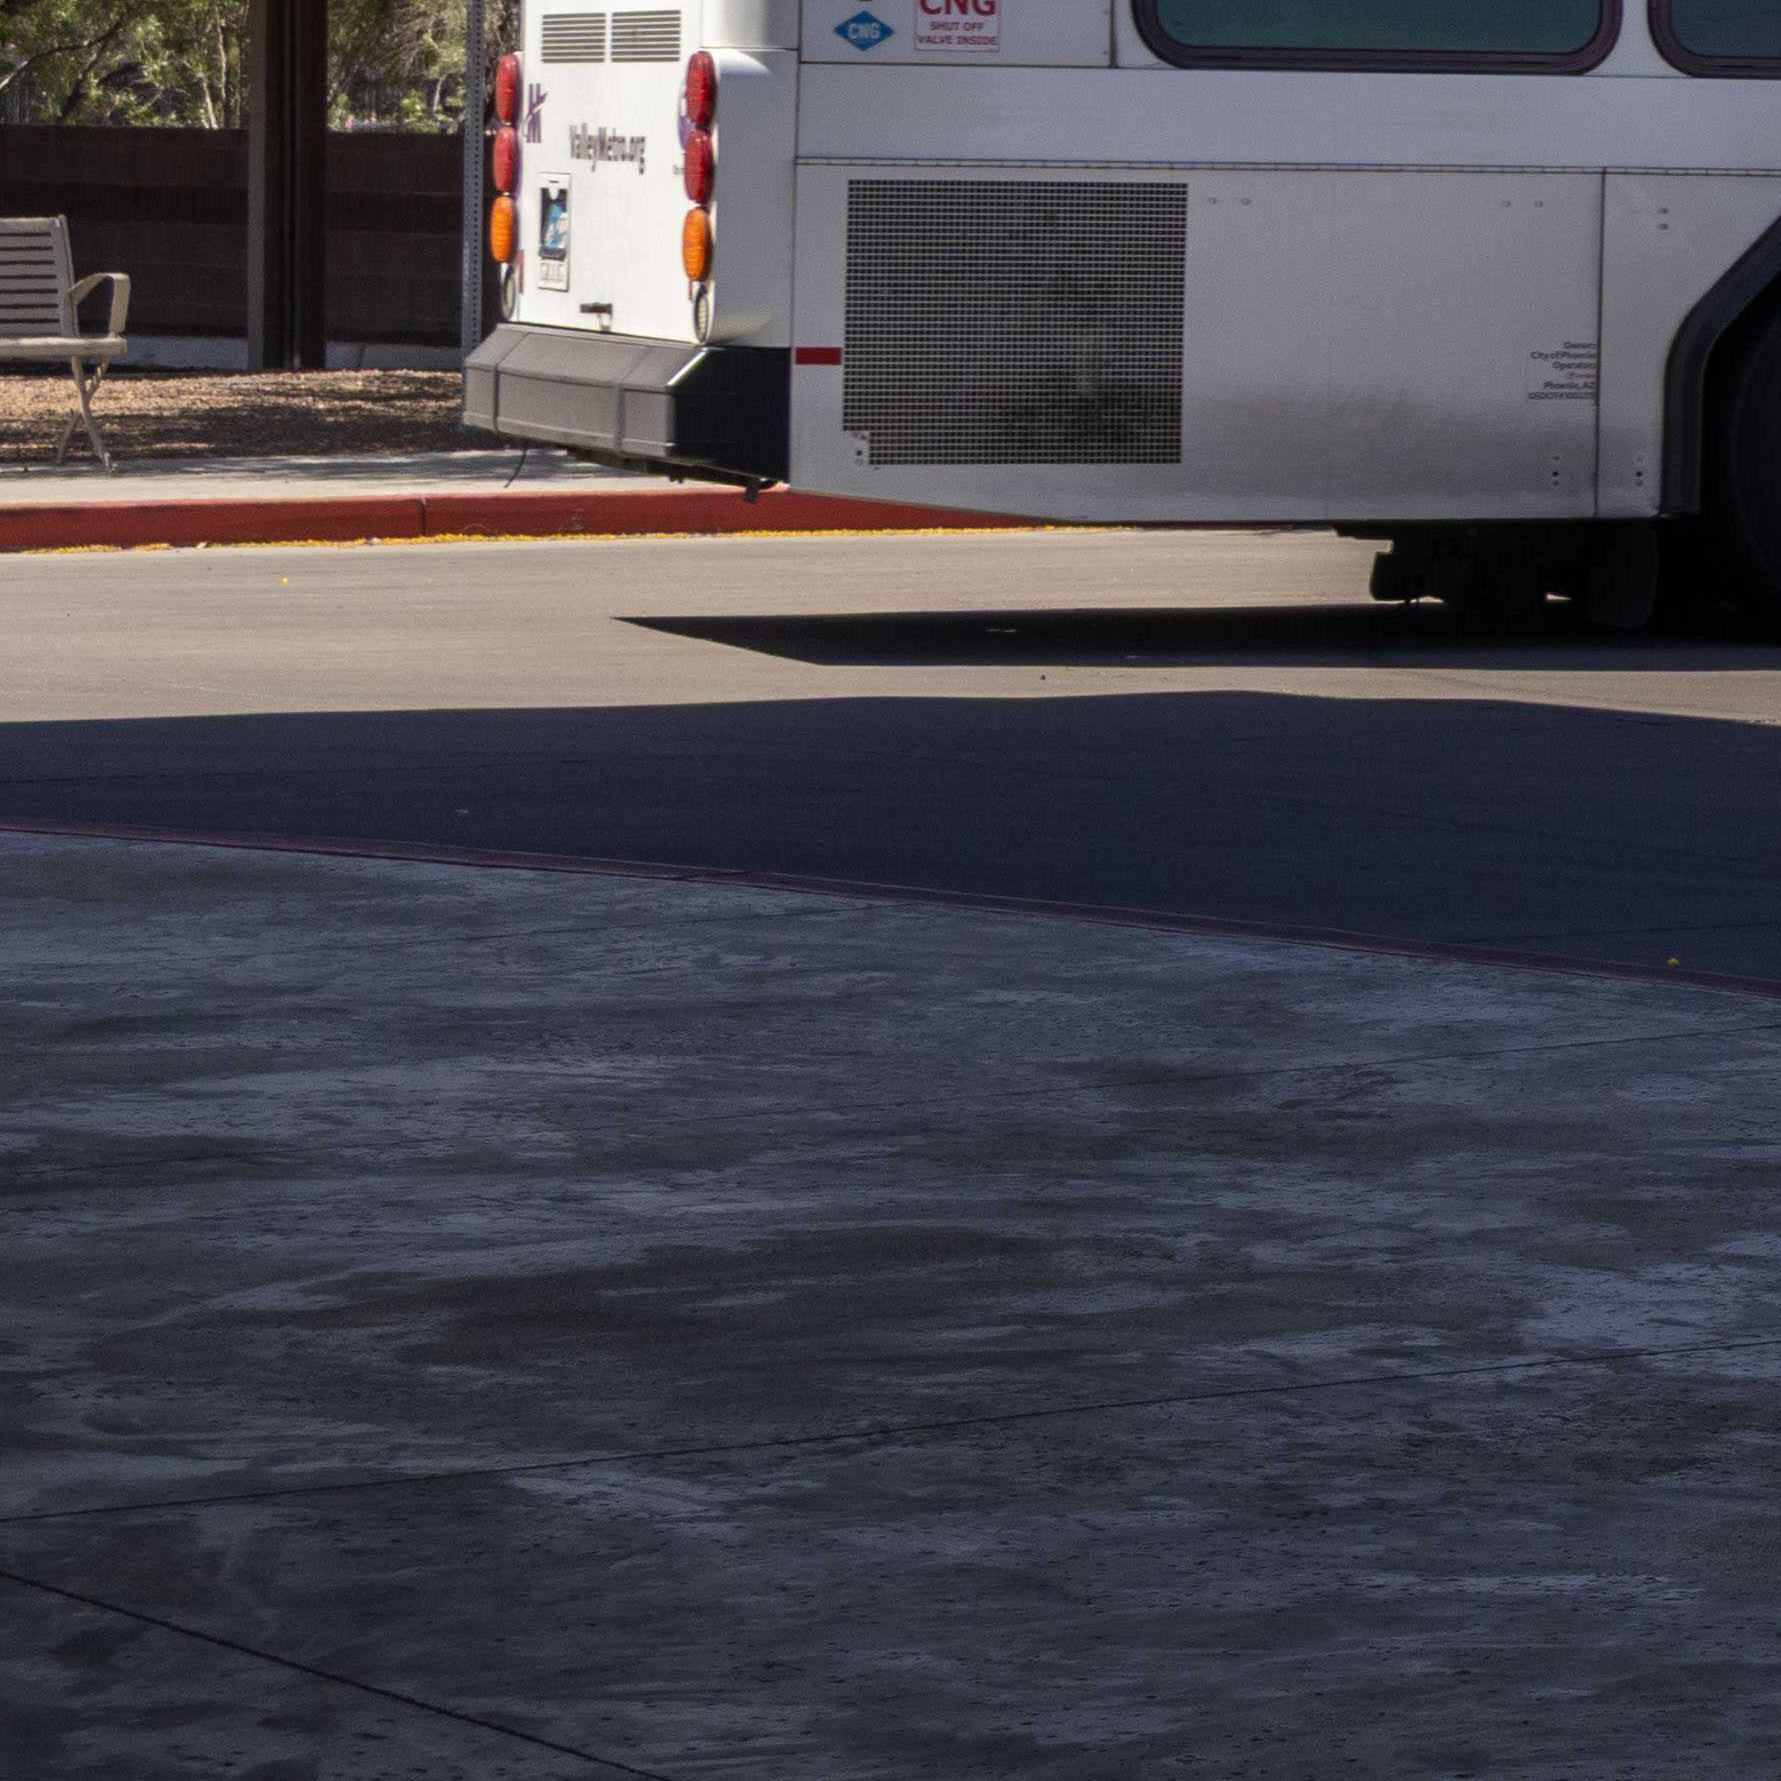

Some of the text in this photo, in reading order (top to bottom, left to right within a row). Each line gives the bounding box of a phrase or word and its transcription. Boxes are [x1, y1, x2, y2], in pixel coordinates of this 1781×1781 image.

[849, 22, 881, 40] CNG
[930, 21, 985, 32] SHUT OFF
[917, 35, 998, 46] VALVE INSIDE
